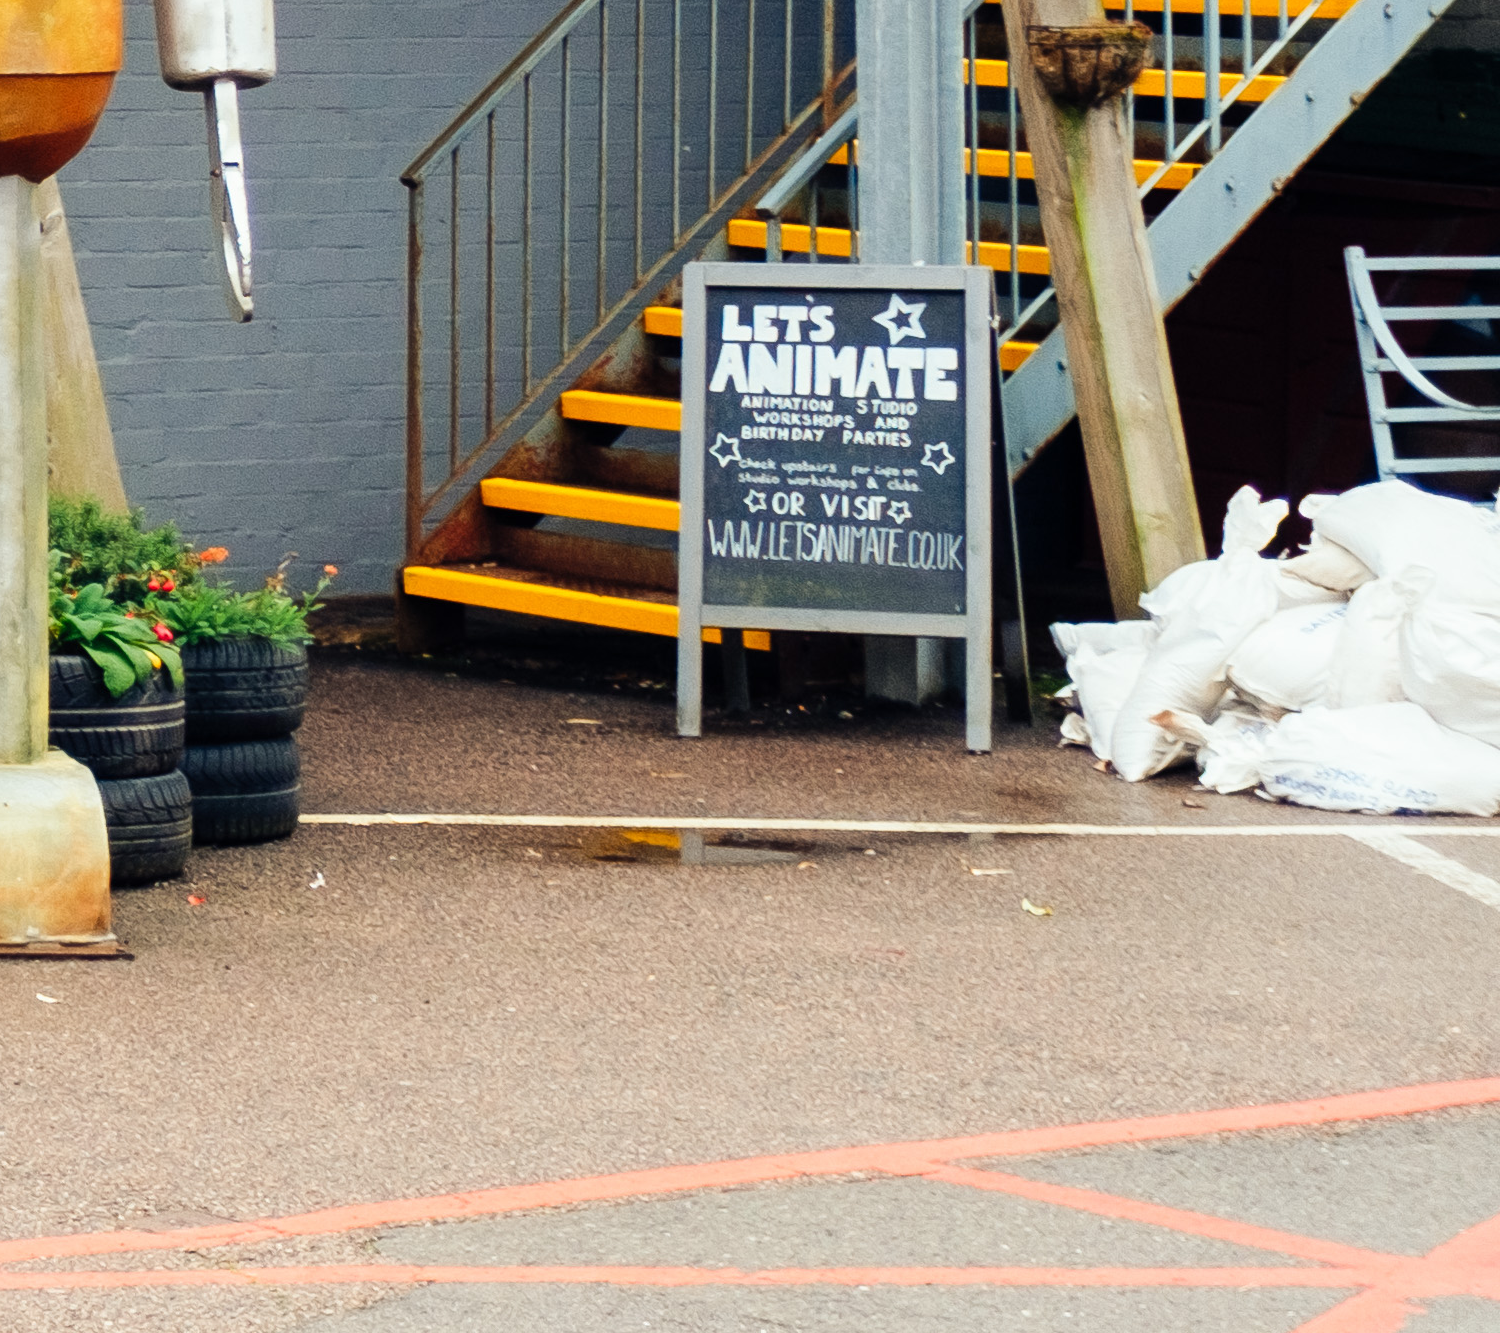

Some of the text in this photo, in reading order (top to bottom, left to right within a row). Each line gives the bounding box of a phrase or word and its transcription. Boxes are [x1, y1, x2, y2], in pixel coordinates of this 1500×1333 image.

[709, 343, 959, 401] ANIMATE
[740, 394, 918, 416] ANIMATION STUDIO
[752, 411, 910, 430] WORKSHOPS AND
[740, 425, 912, 448] BIRTHDAY PARTIES
[771, 491, 888, 522] OR VISIT
